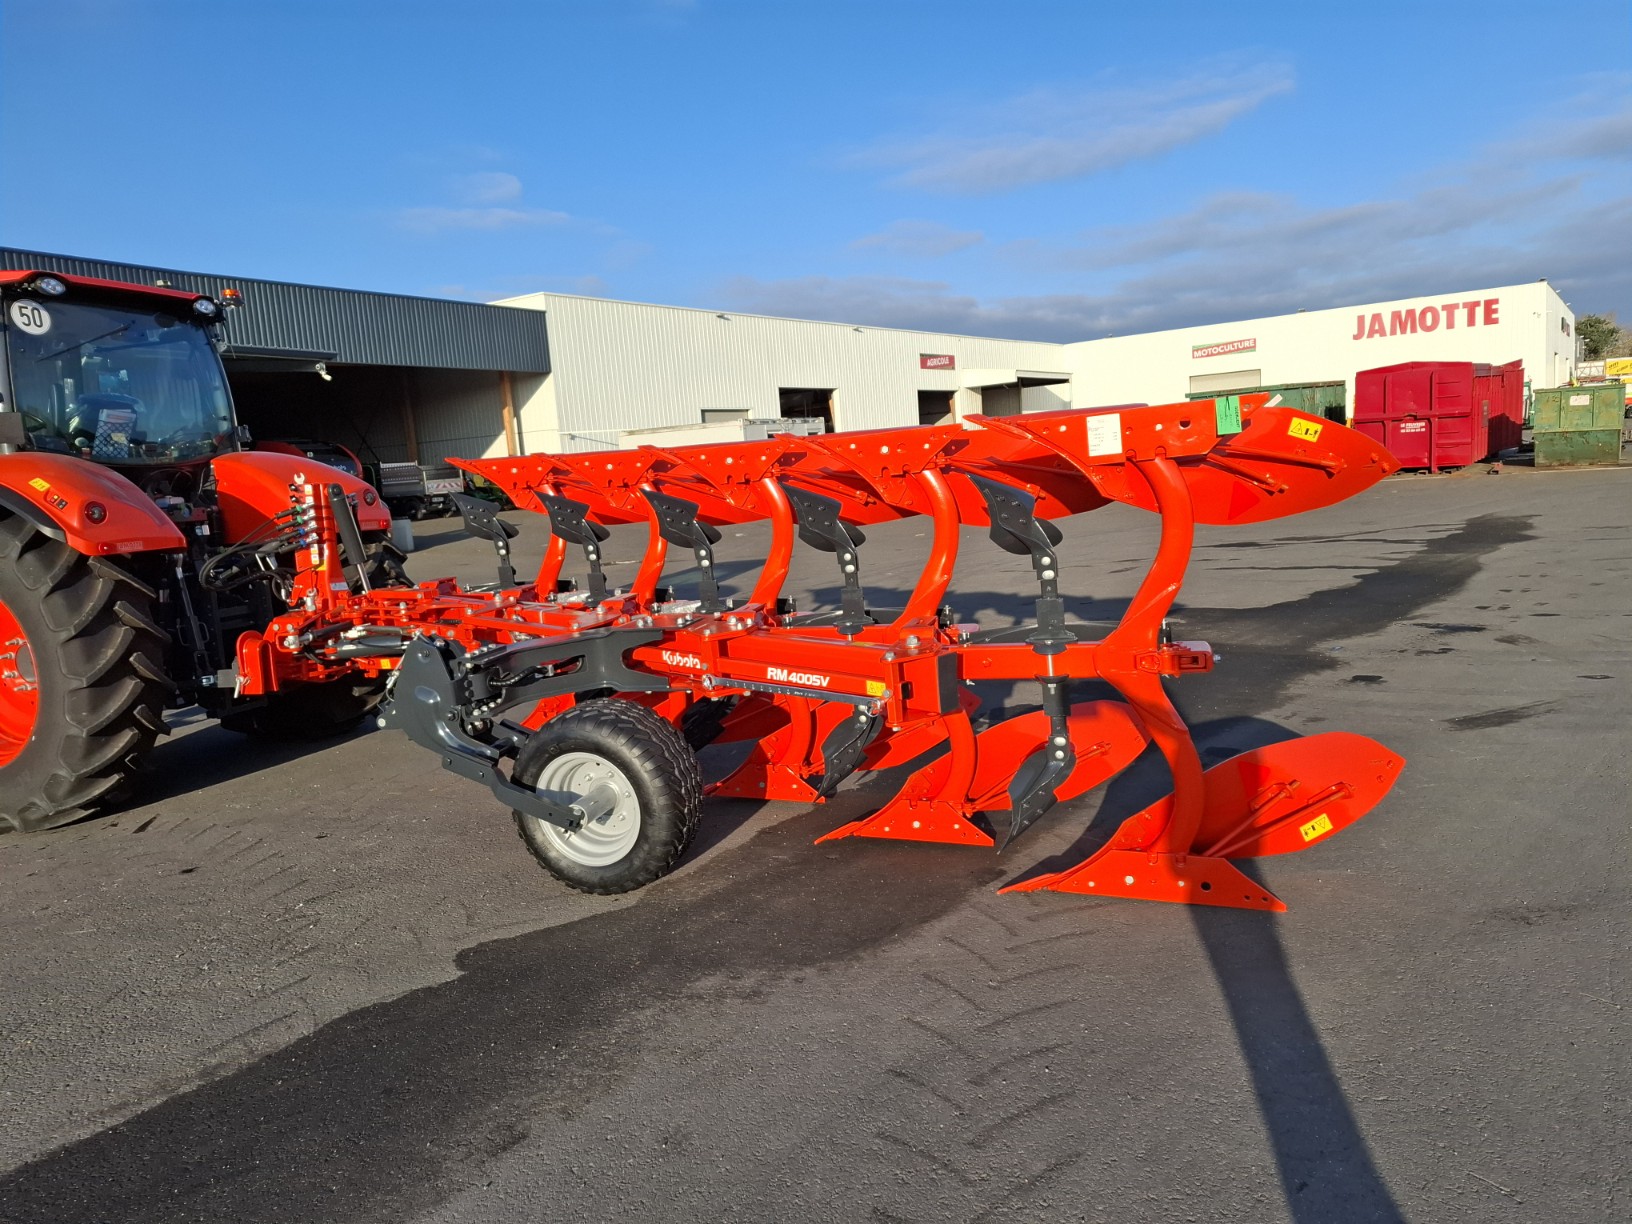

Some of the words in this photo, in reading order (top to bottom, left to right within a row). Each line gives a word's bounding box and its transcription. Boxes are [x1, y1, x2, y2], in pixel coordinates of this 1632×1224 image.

[17, 305, 44, 328] 50
[1353, 298, 1499, 340] JAMOTTE
[1193, 339, 1255, 358] MOTOCULTURE
[926, 356, 950, 367] AGRICOLE
[662, 650, 701, 669] Kubota
